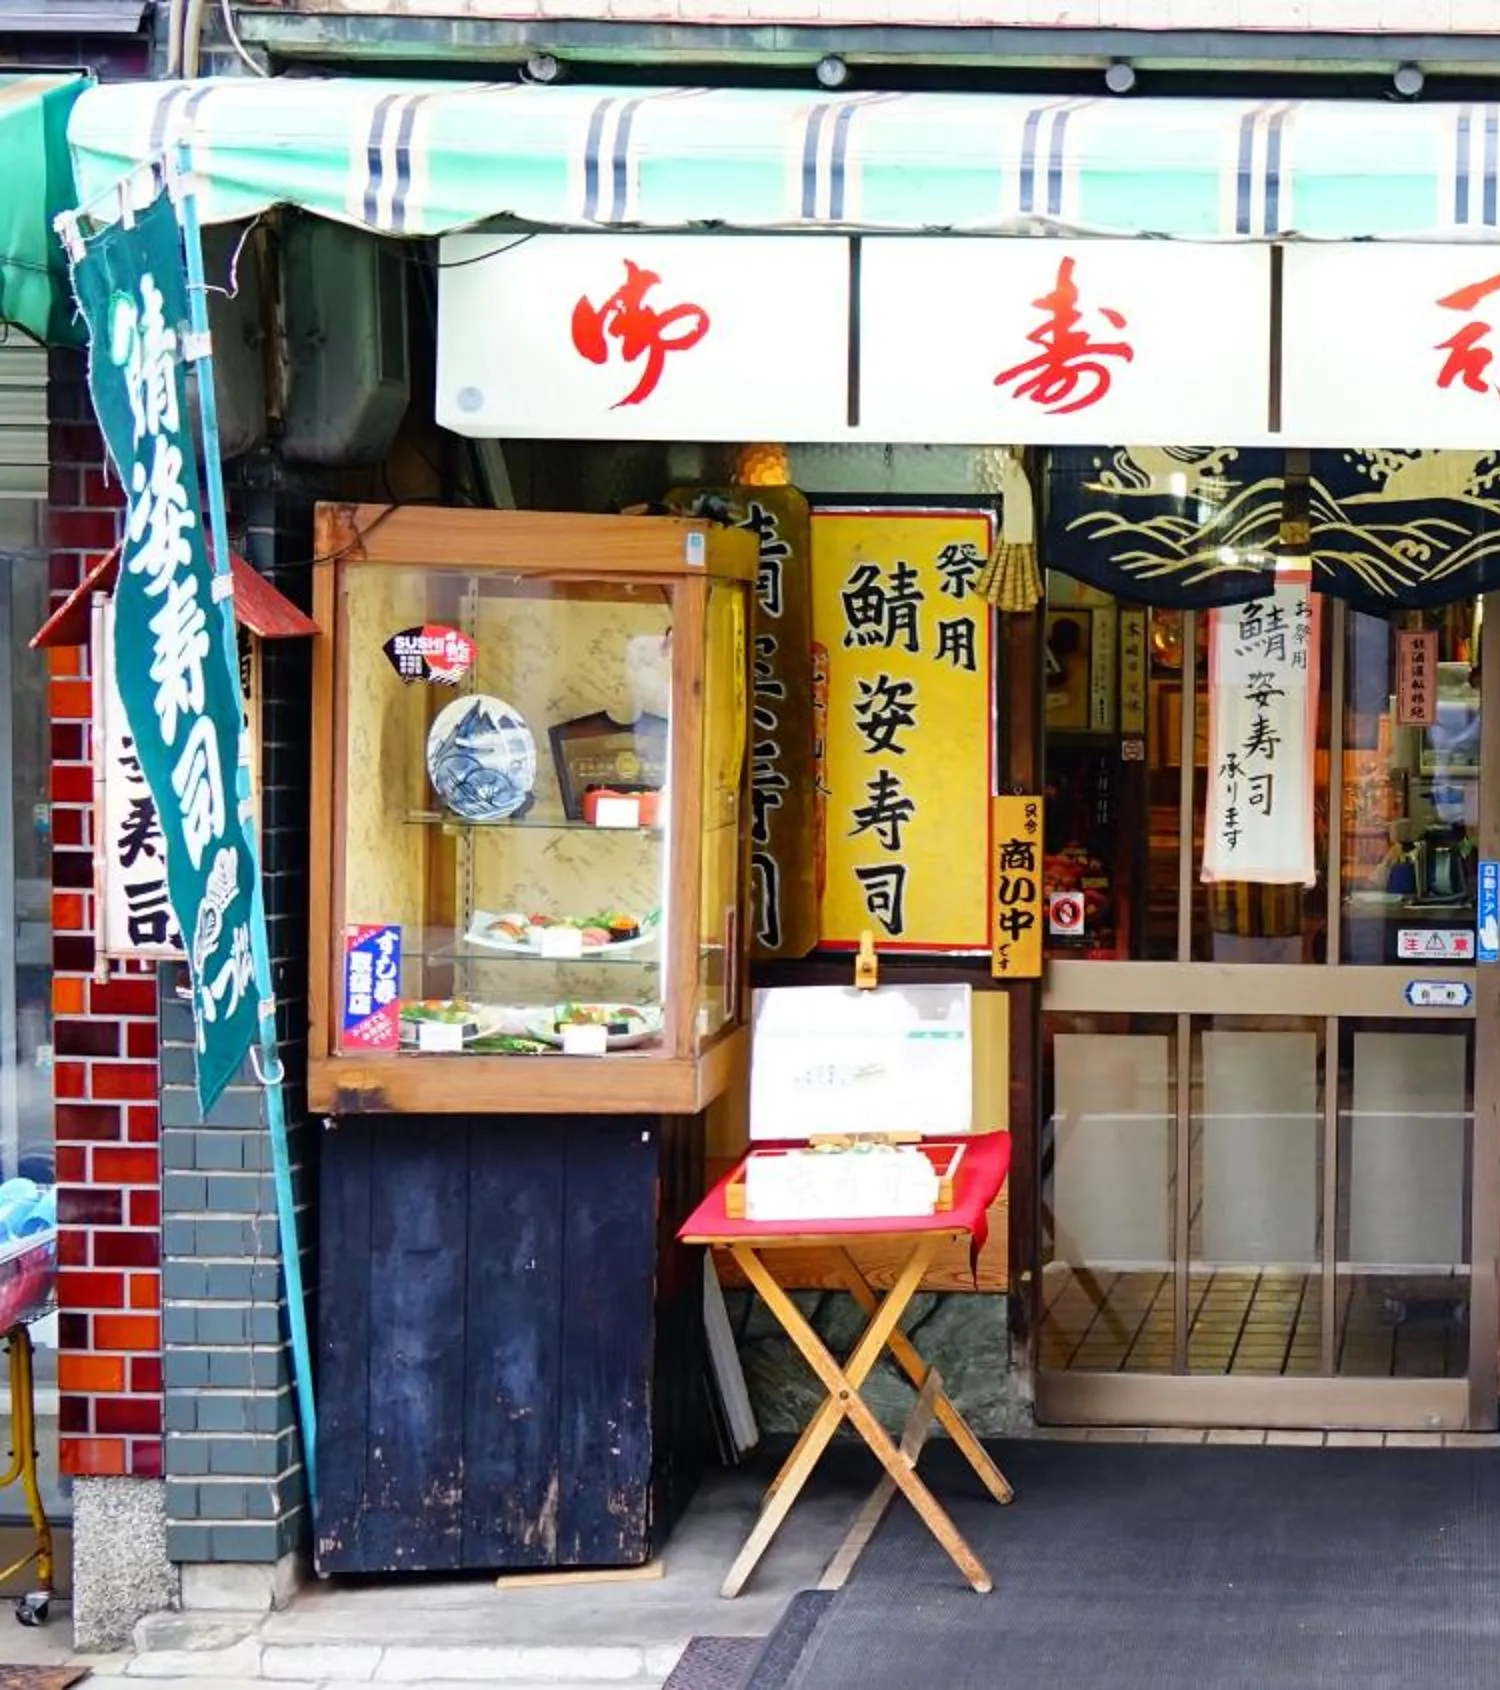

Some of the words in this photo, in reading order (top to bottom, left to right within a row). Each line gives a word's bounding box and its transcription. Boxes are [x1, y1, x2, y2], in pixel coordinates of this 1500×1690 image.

[394, 635, 445, 650] SUSHI
[935, 543, 988, 671] 祭用
[841, 561, 925, 937] 鯖姿寿司
[1233, 601, 1290, 817] 鯖姿寿司
[1218, 753, 1246, 852] 承ります
[998, 838, 1038, 941] 商い中
[1483, 865, 1497, 914] 自動ドア
